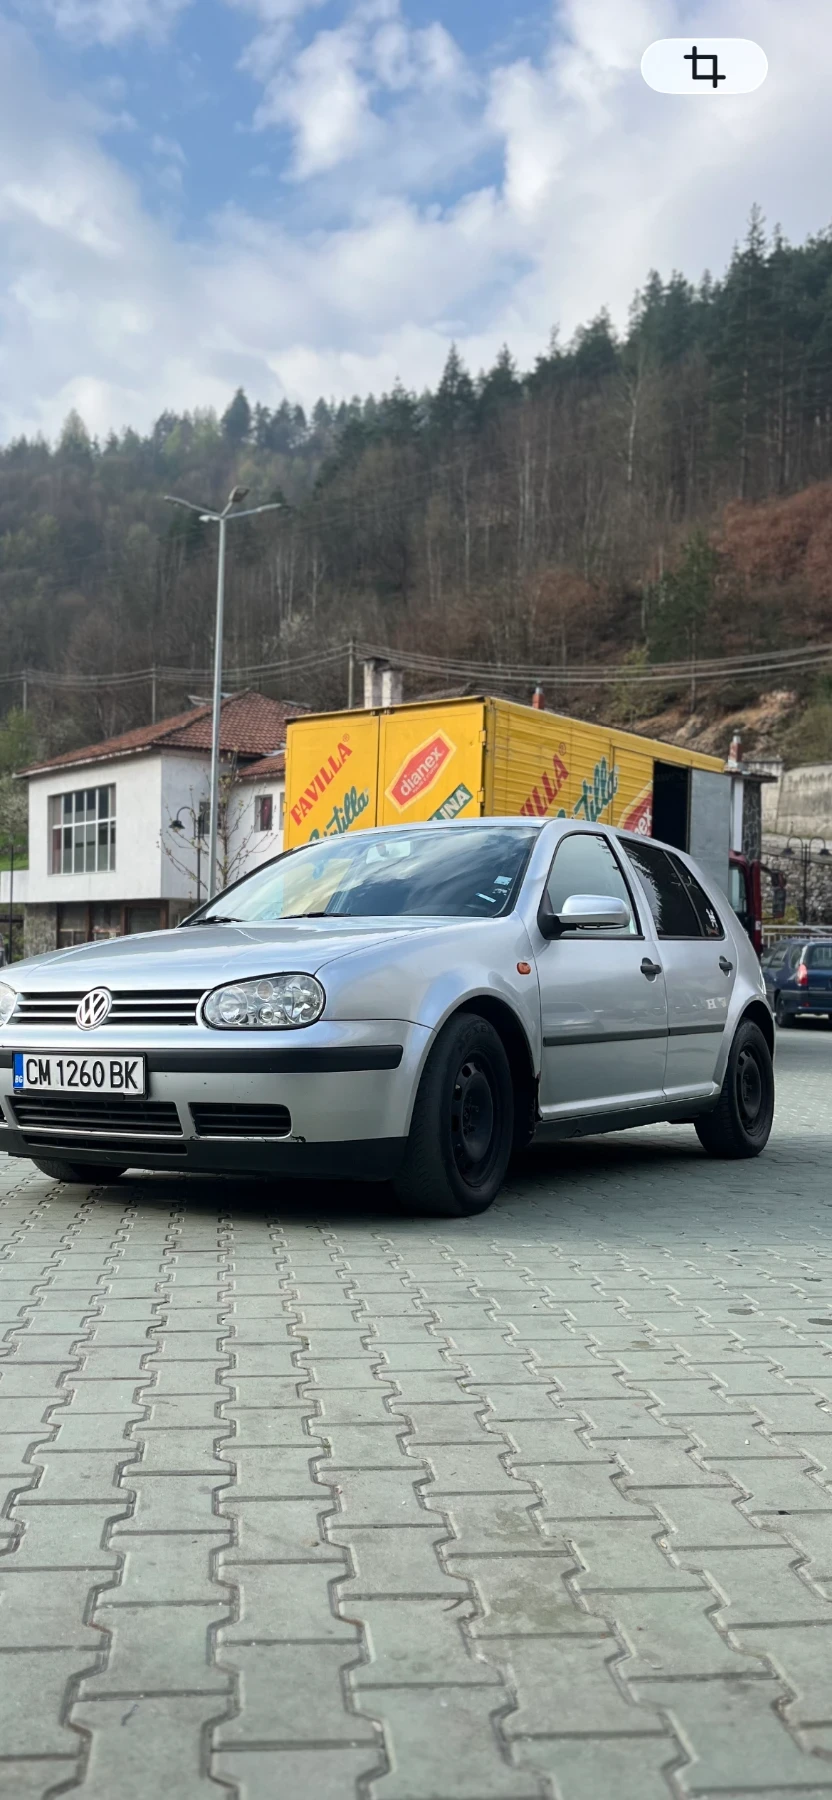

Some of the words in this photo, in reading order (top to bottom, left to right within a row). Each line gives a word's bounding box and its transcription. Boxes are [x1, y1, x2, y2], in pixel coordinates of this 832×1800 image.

[290, 742, 353, 826] FAVILLA
[400, 747, 442, 796] dianex
[431, 789, 471, 820] INA
[14, 1075, 24, 1084] BG
[26, 1058, 52, 1086] CM
[56, 1060, 105, 1088] 1260
[109, 1060, 139, 1090] BK
